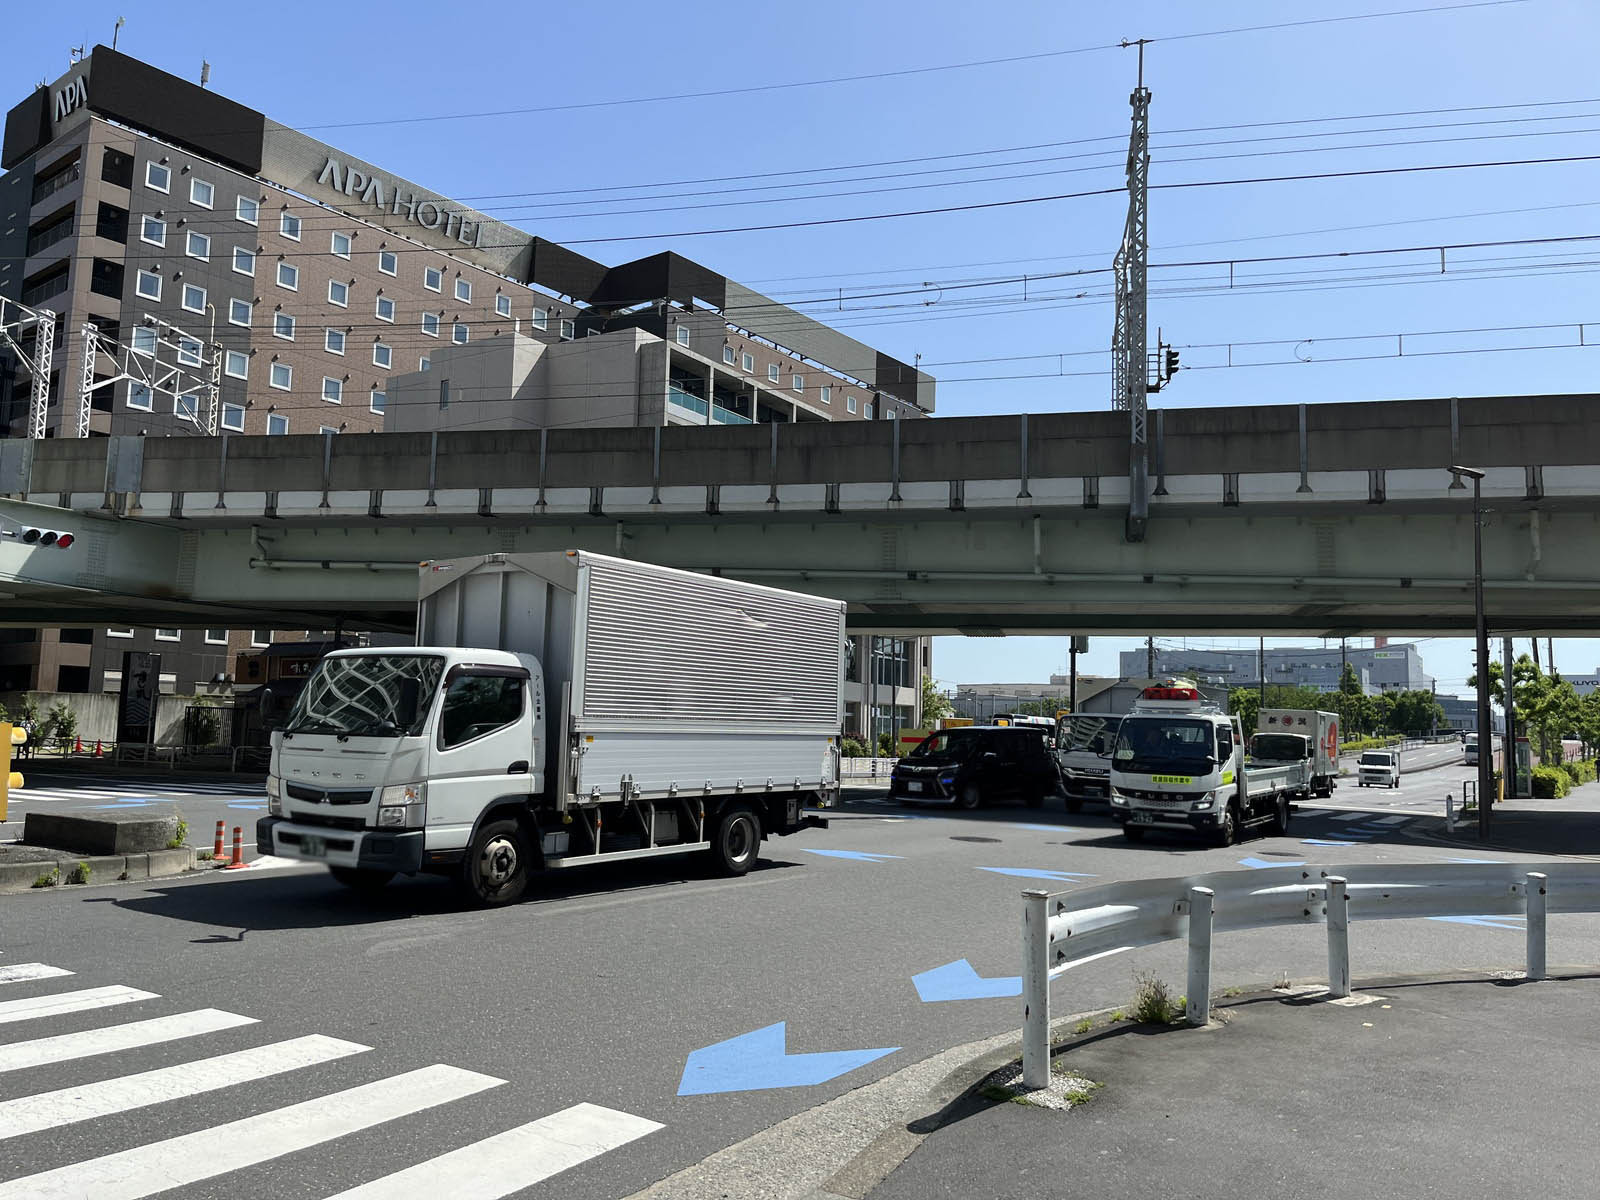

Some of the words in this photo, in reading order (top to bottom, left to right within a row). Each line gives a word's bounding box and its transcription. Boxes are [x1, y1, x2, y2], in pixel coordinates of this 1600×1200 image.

[55, 75, 87, 122] APA
[318, 158, 385, 209] APA
[392, 187, 481, 248] HOTEL
[1135, 792, 1184, 801] FUSO
